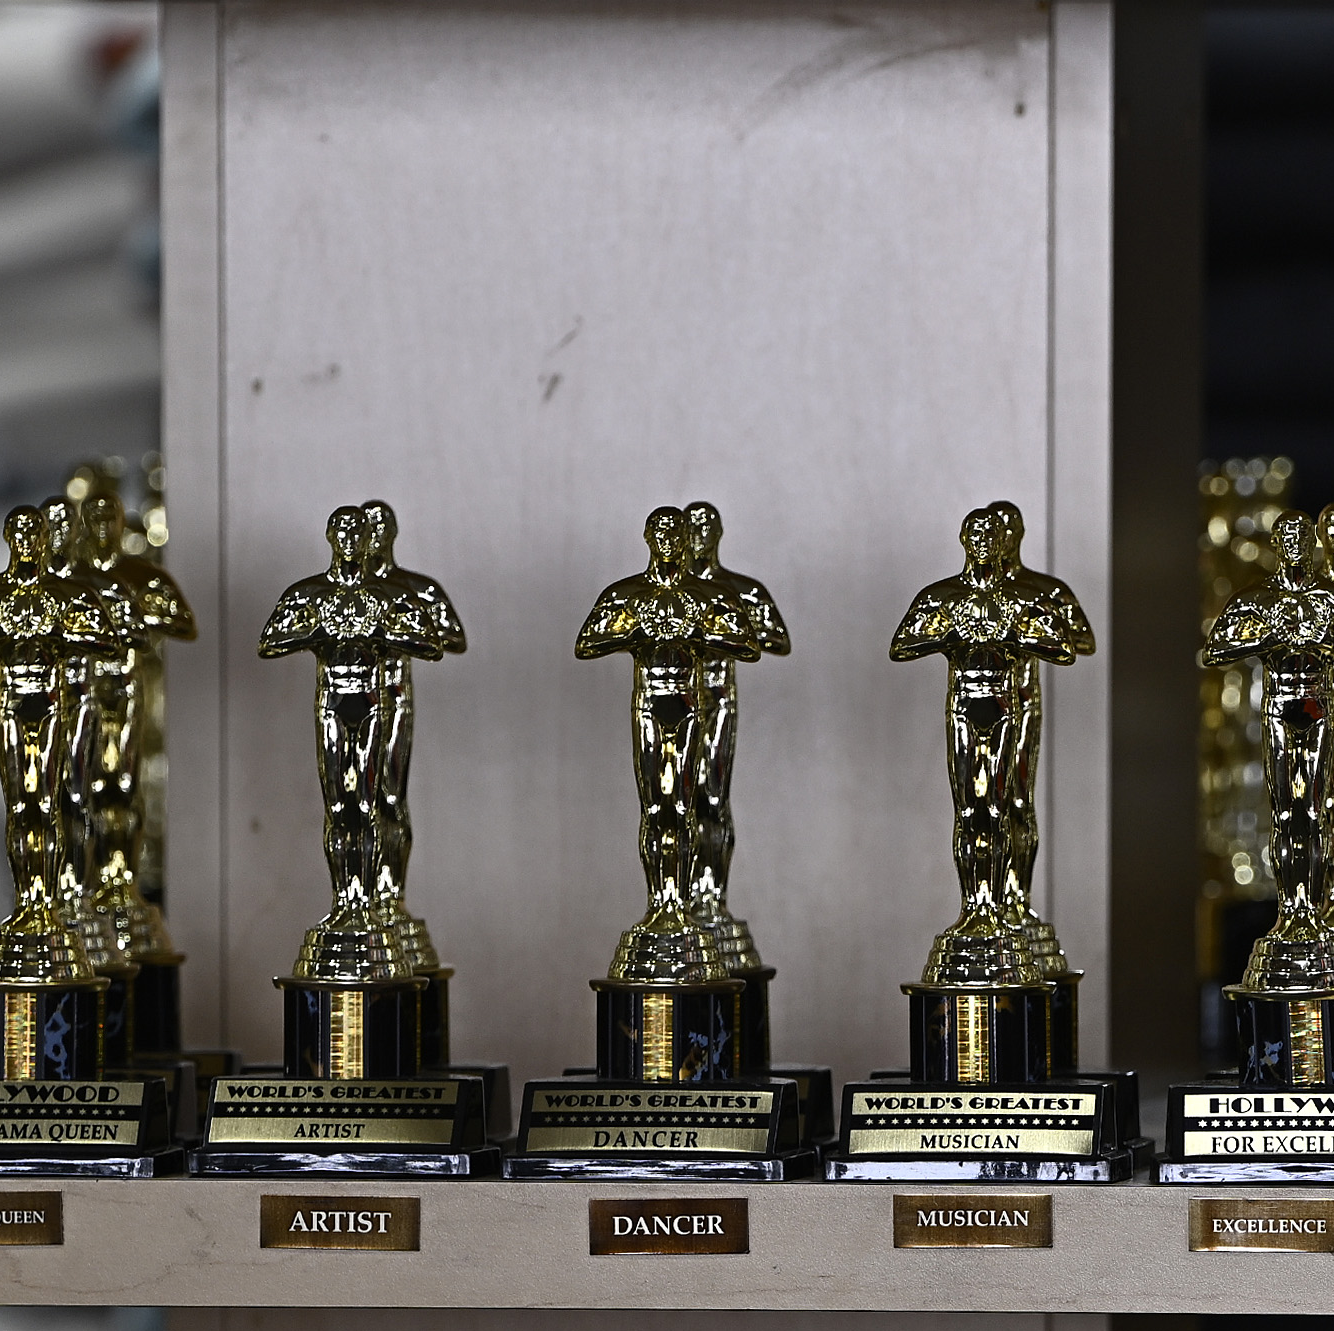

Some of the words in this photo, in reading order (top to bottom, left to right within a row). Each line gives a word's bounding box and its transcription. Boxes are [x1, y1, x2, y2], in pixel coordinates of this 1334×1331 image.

[227, 1085, 325, 1100] WORLD'S
[330, 1085, 446, 1100] GREATEST
[544, 1094, 641, 1109] WORLD'S
[646, 1094, 761, 1110] GREATEST
[864, 1096, 963, 1111] WORLD'S
[967, 1096, 1084, 1111] GREATEST
[49, 1123, 119, 1142] QUEEN
[293, 1123, 366, 1139] ARTIST
[594, 1130, 698, 1148] DANCER
[919, 1134, 1020, 1151] MUSICIAN
[1211, 1135, 1257, 1153] FOR
[289, 1212, 392, 1233] ARTIST
[613, 1215, 724, 1236] DANCER
[917, 1209, 1029, 1227] MUSICIAN
[1212, 1218, 1327, 1234] EXCELLENCE
